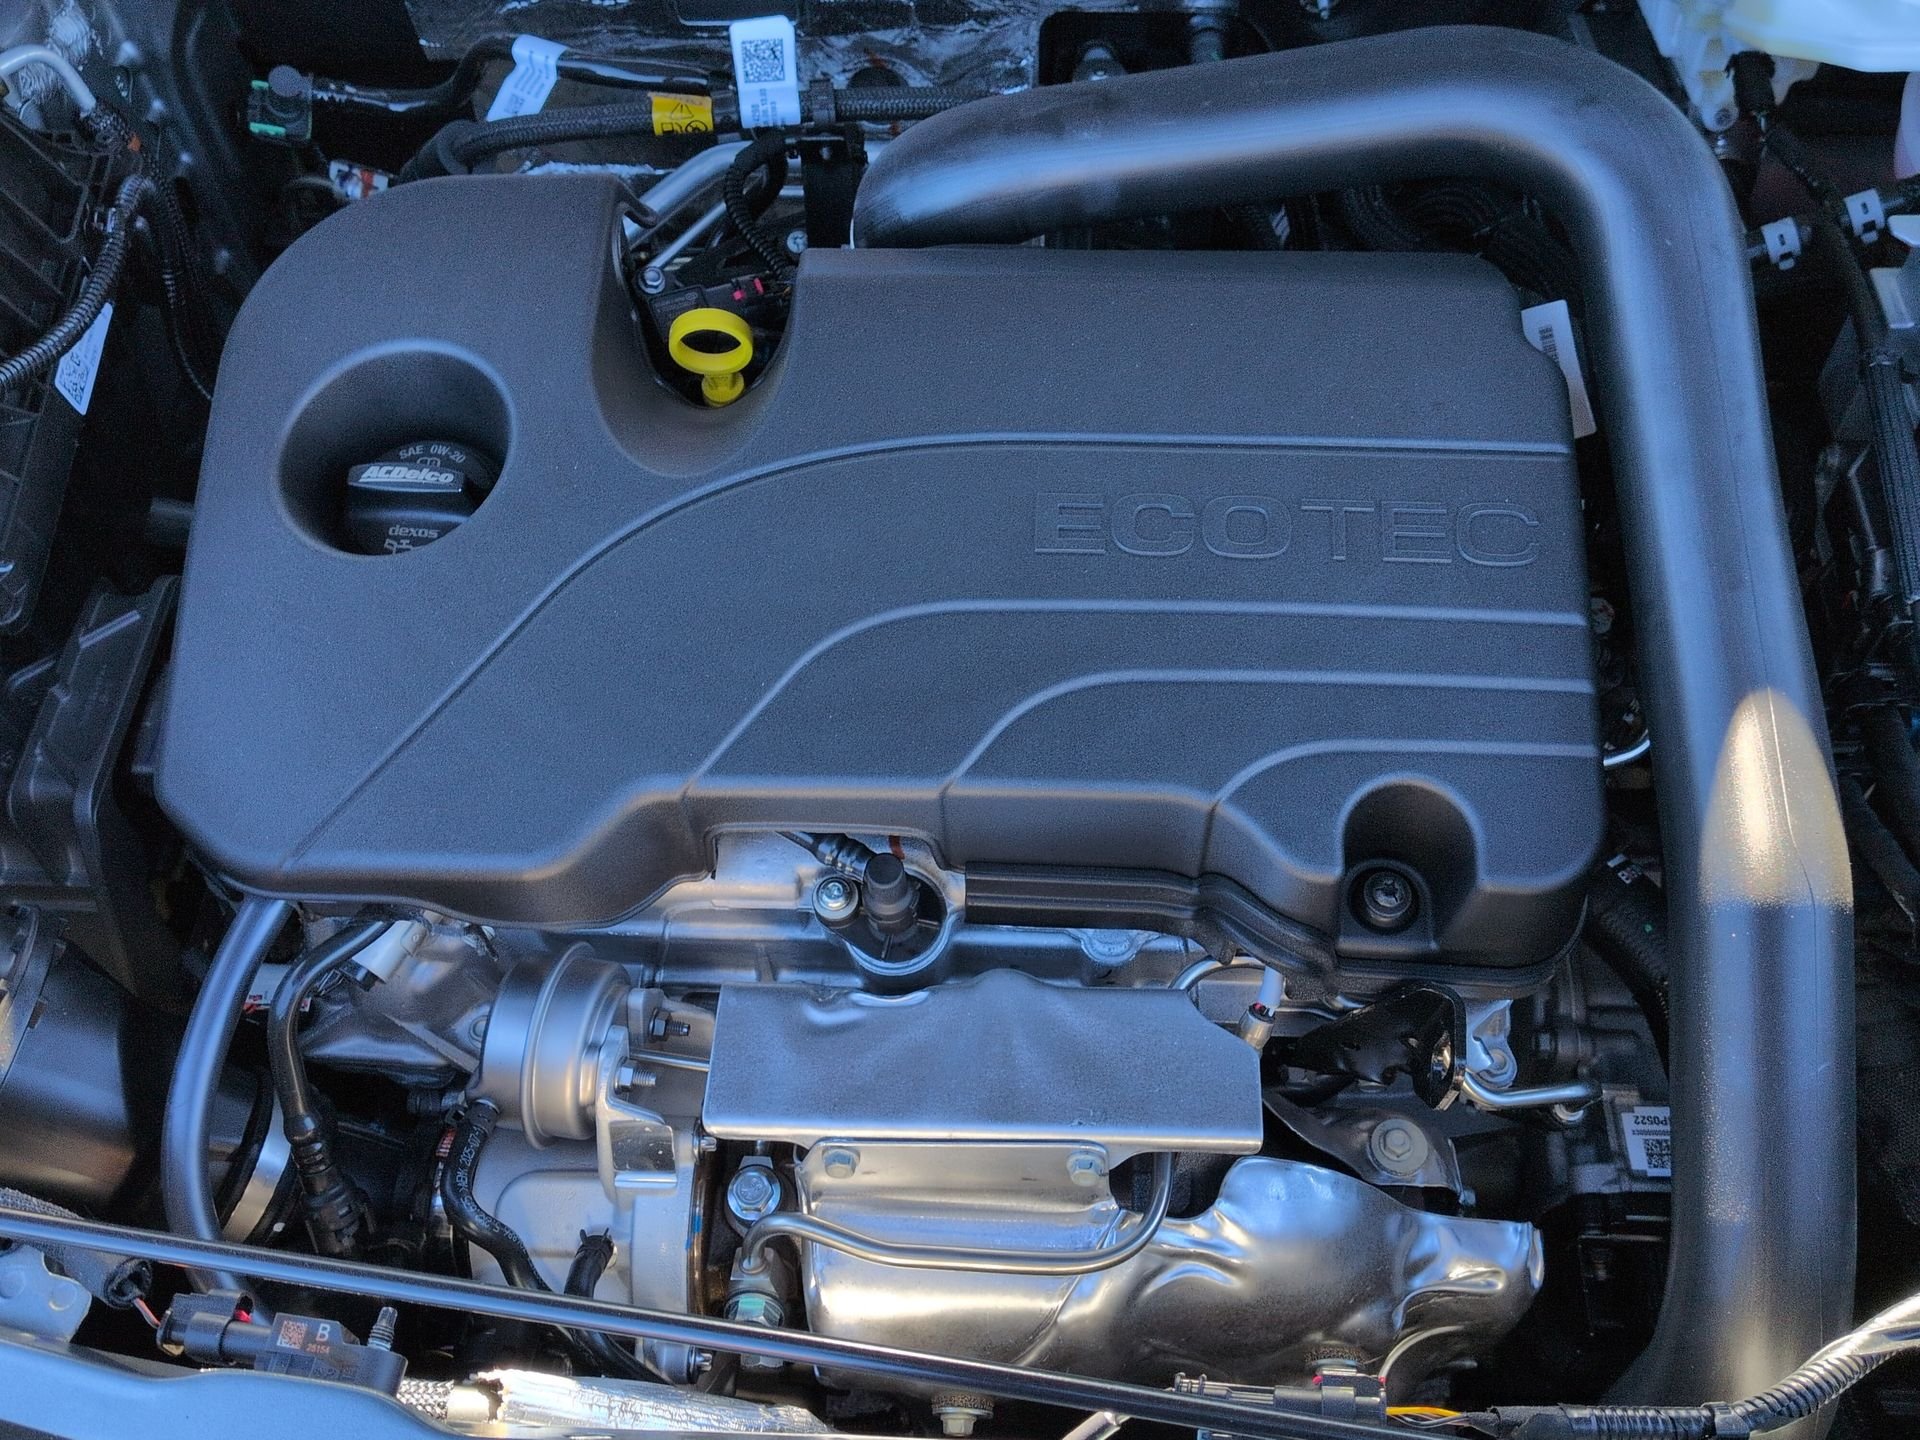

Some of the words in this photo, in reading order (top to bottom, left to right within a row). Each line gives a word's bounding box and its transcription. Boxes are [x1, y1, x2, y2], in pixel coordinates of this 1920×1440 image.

[399, 445, 424, 459] SAE
[430, 444, 466, 463] 0W-20
[359, 466, 454, 483] ACDelco
[388, 525, 440, 538] dexos
[1034, 492, 1540, 567] ECOTEC
[315, 1323, 330, 1342] B
